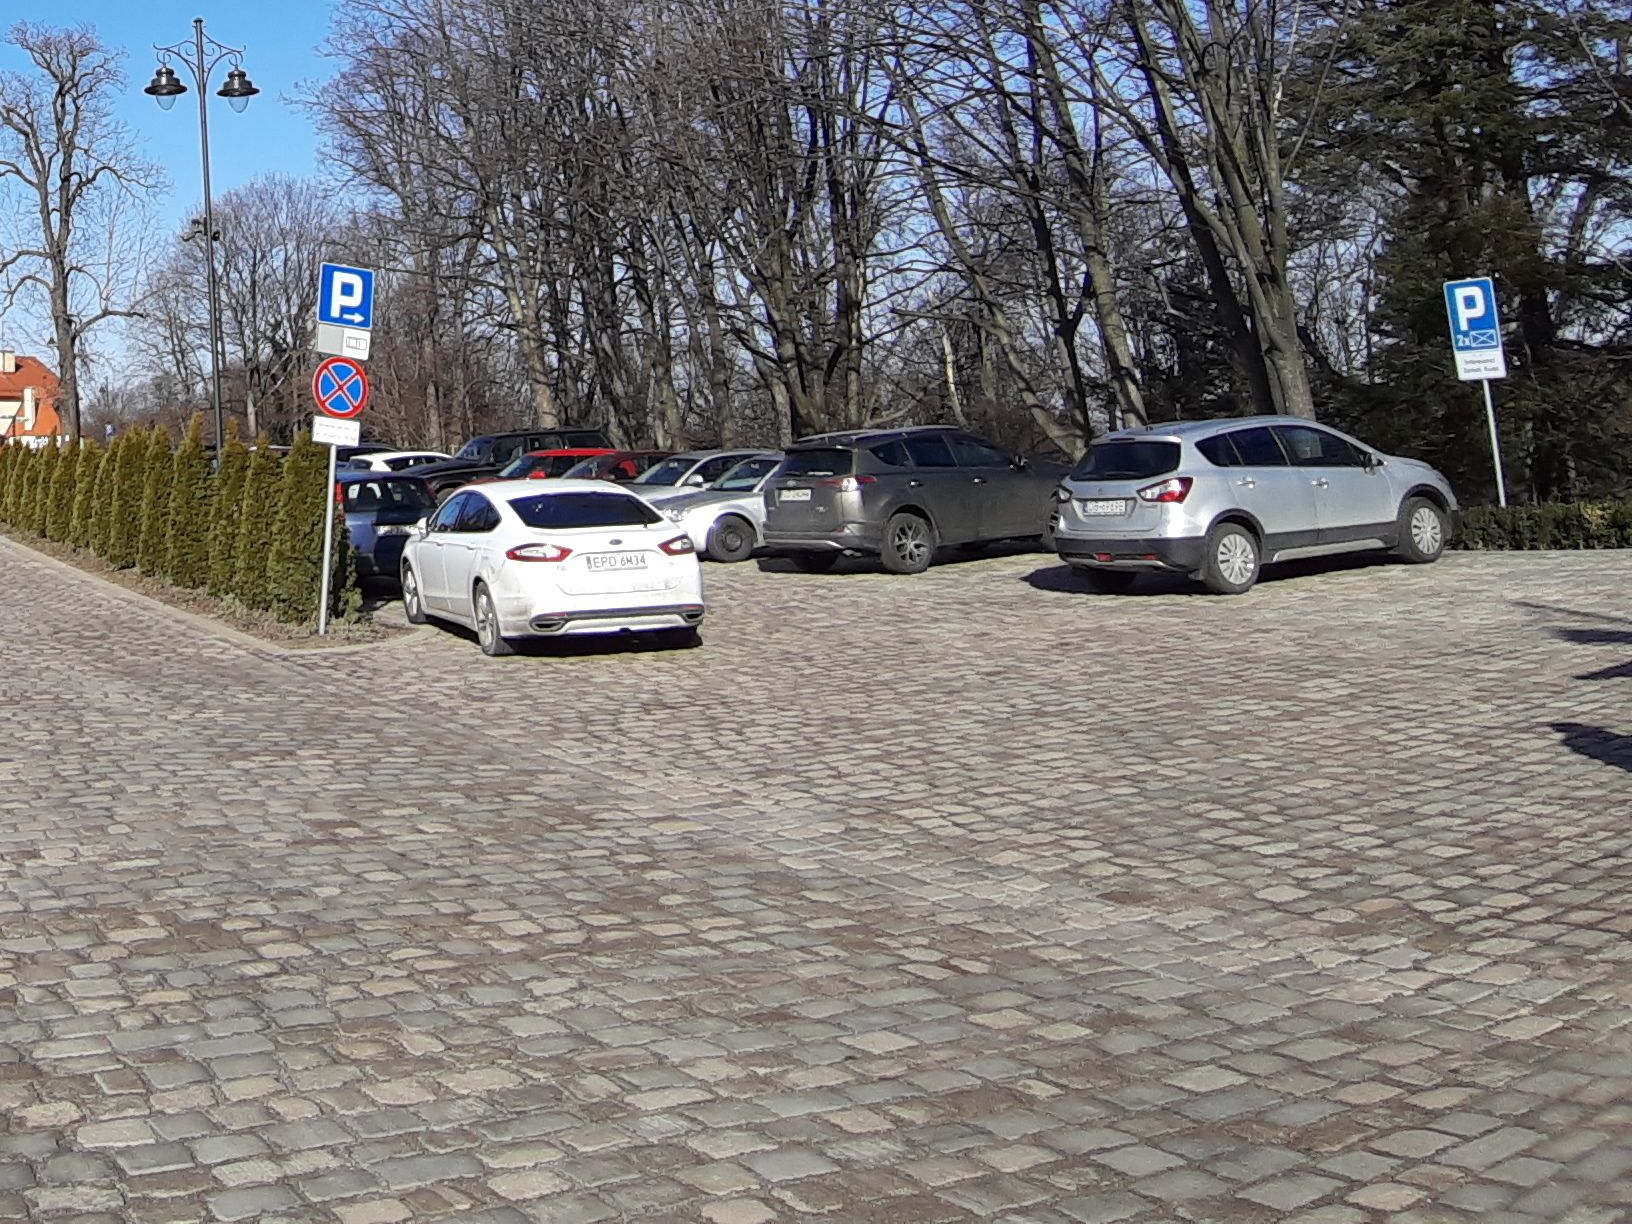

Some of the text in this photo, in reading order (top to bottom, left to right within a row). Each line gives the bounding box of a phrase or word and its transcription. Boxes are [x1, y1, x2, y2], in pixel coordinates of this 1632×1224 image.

[331, 270, 363, 318] P
[1454, 286, 1485, 331] P
[593, 556, 617, 568] EPD
